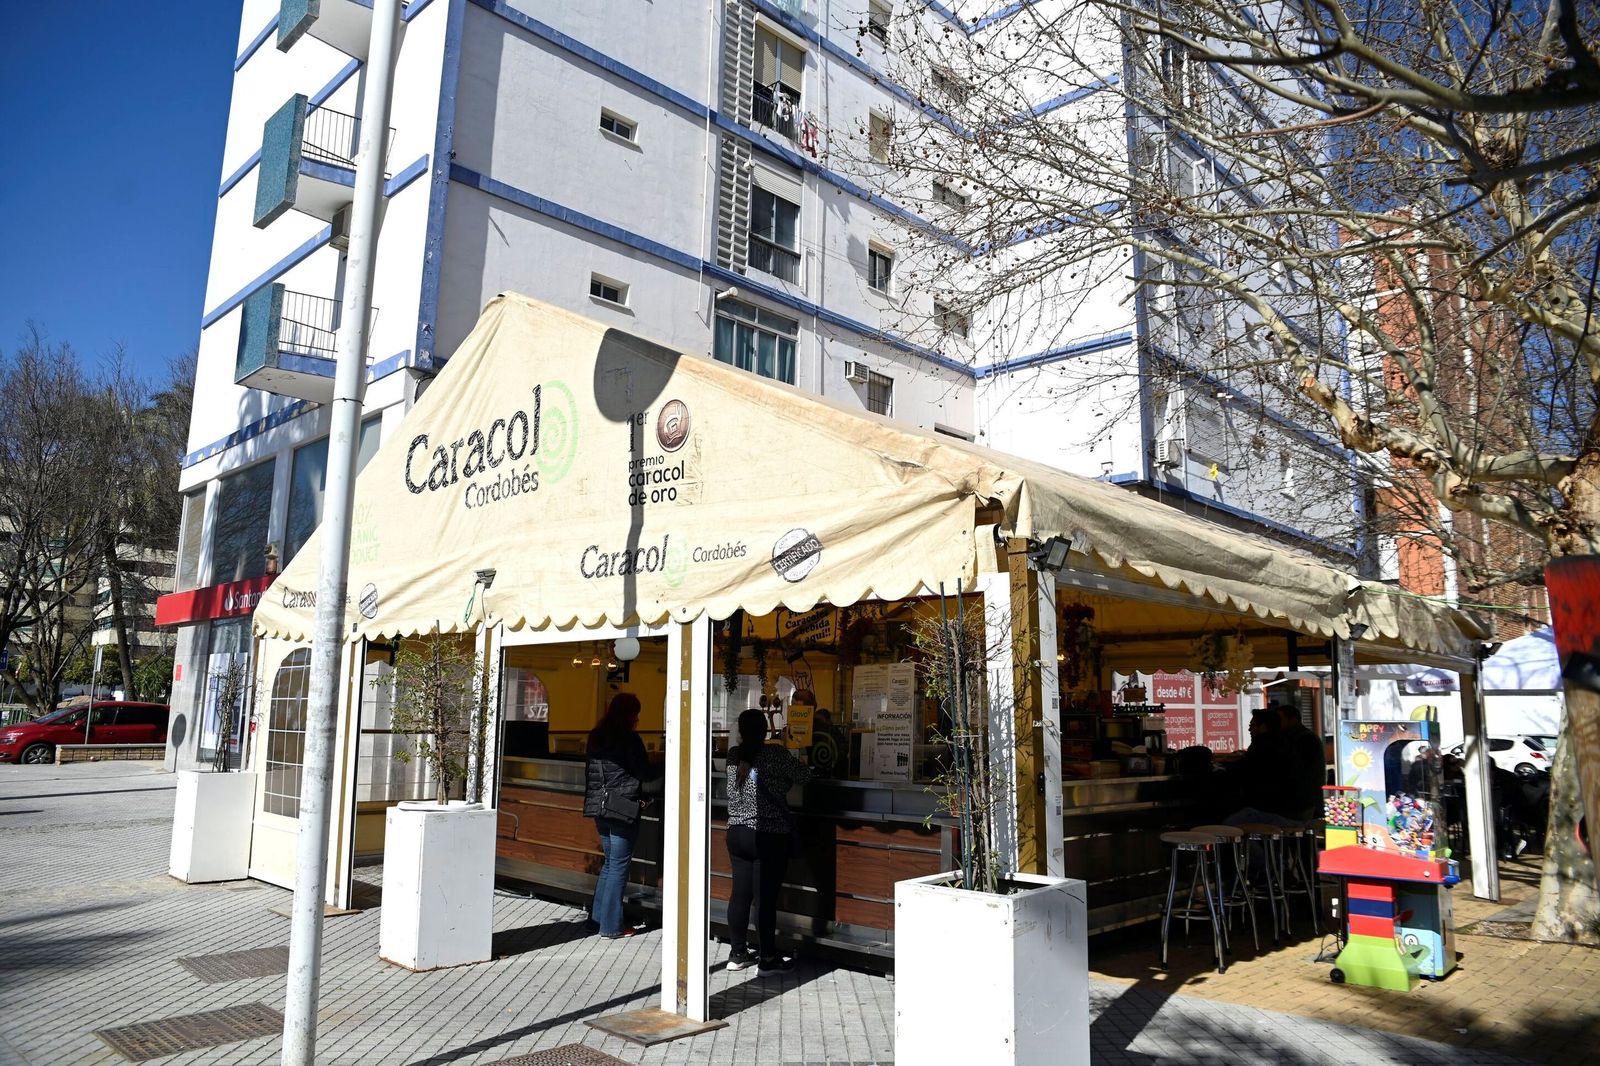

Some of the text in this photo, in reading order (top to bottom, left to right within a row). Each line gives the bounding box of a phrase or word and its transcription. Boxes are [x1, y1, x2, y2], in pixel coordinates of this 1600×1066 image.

[405, 384, 541, 494] Caracol
[628, 455, 665, 473] premio
[628, 460, 685, 488] caracol
[464, 464, 539, 509] Cordobés
[628, 486, 677, 507] de oro
[580, 534, 669, 579] Caracol
[692, 541, 747, 563] Cordobés
[774, 538, 820, 572] CERTIFICADO
[1157, 685, 1178, 698] desde
[1179, 686, 1187, 698] 49
[877, 712, 912, 720] INFORMACIÓN
